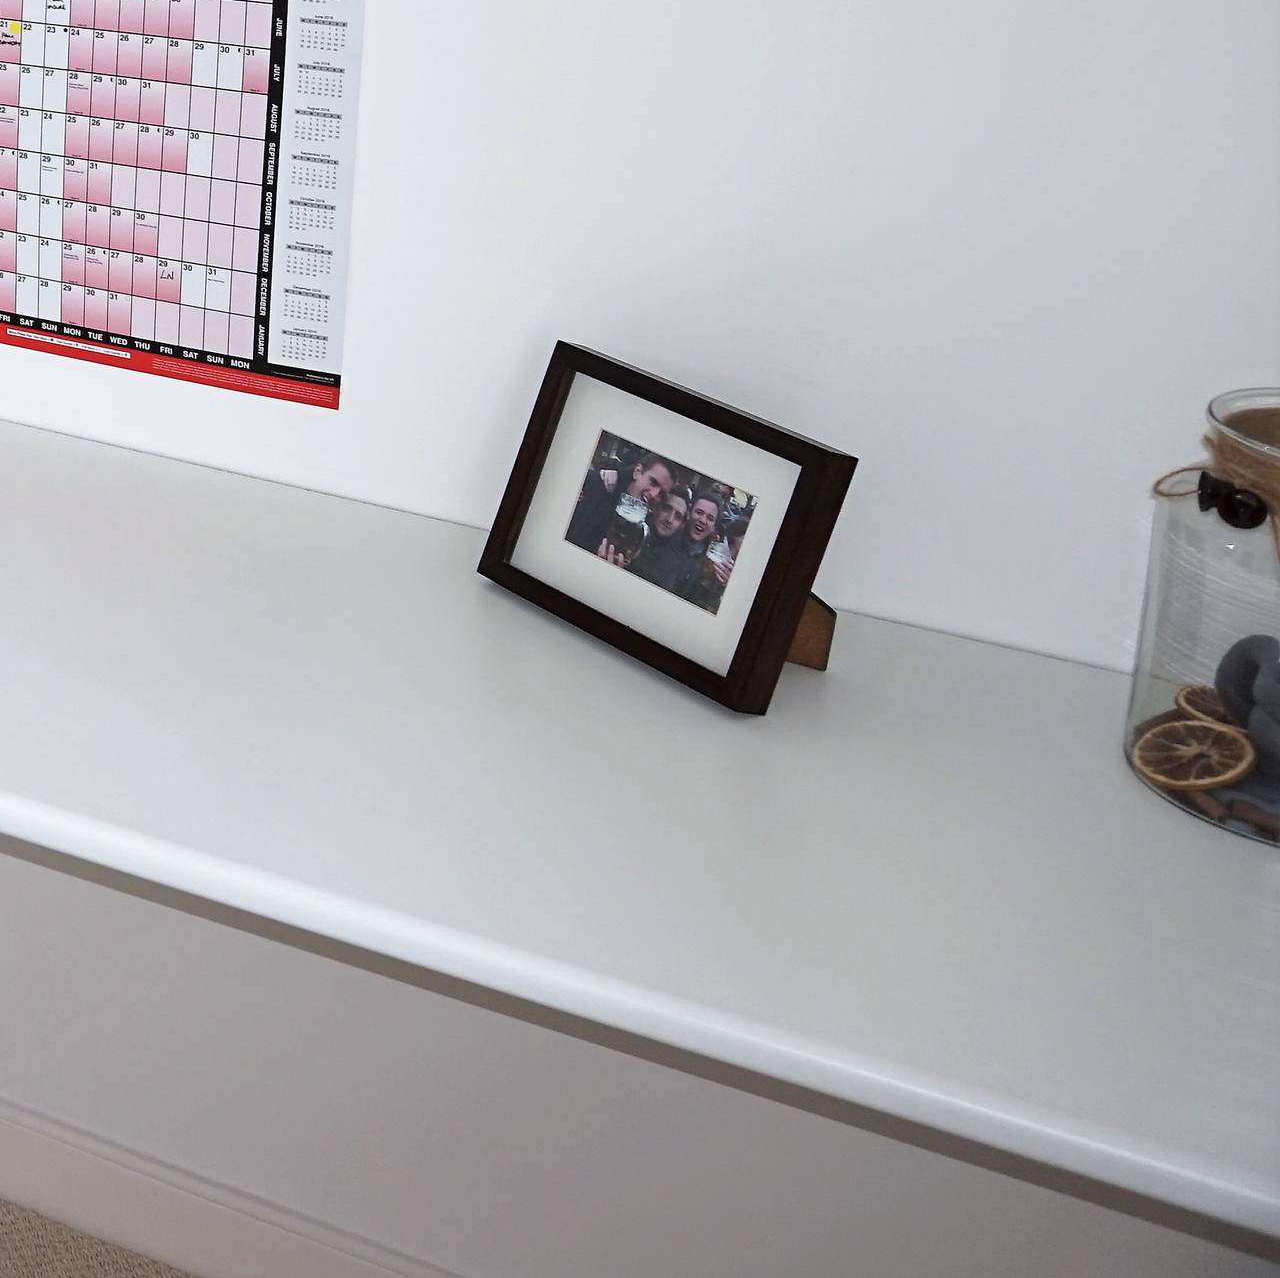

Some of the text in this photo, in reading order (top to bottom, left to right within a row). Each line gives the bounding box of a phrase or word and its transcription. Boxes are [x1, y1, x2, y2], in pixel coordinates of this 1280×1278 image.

[275, 17, 284, 37] JUNE
[273, 63, 281, 82] JULY
[270, 103, 279, 134] AUGUST
[266, 142, 276, 186] SEPTEMBER
[264, 191, 273, 226] OCTOBER
[261, 233, 271, 273] NOVEMBER
[259, 277, 268, 317] DECEMBER
[19, 317, 35, 327] SAT
[41, 322, 58, 332] SUN
[63, 326, 82, 337] MON
[87, 331, 104, 341] TUE
[109, 335, 128, 346] WED
[134, 340, 151, 351] THU
[159, 345, 173, 355] FRI
[182, 350, 199, 360] SAT
[206, 354, 224, 365] SUN
[230, 358, 250, 370] MON
[257, 324, 266, 357] JANUARY
